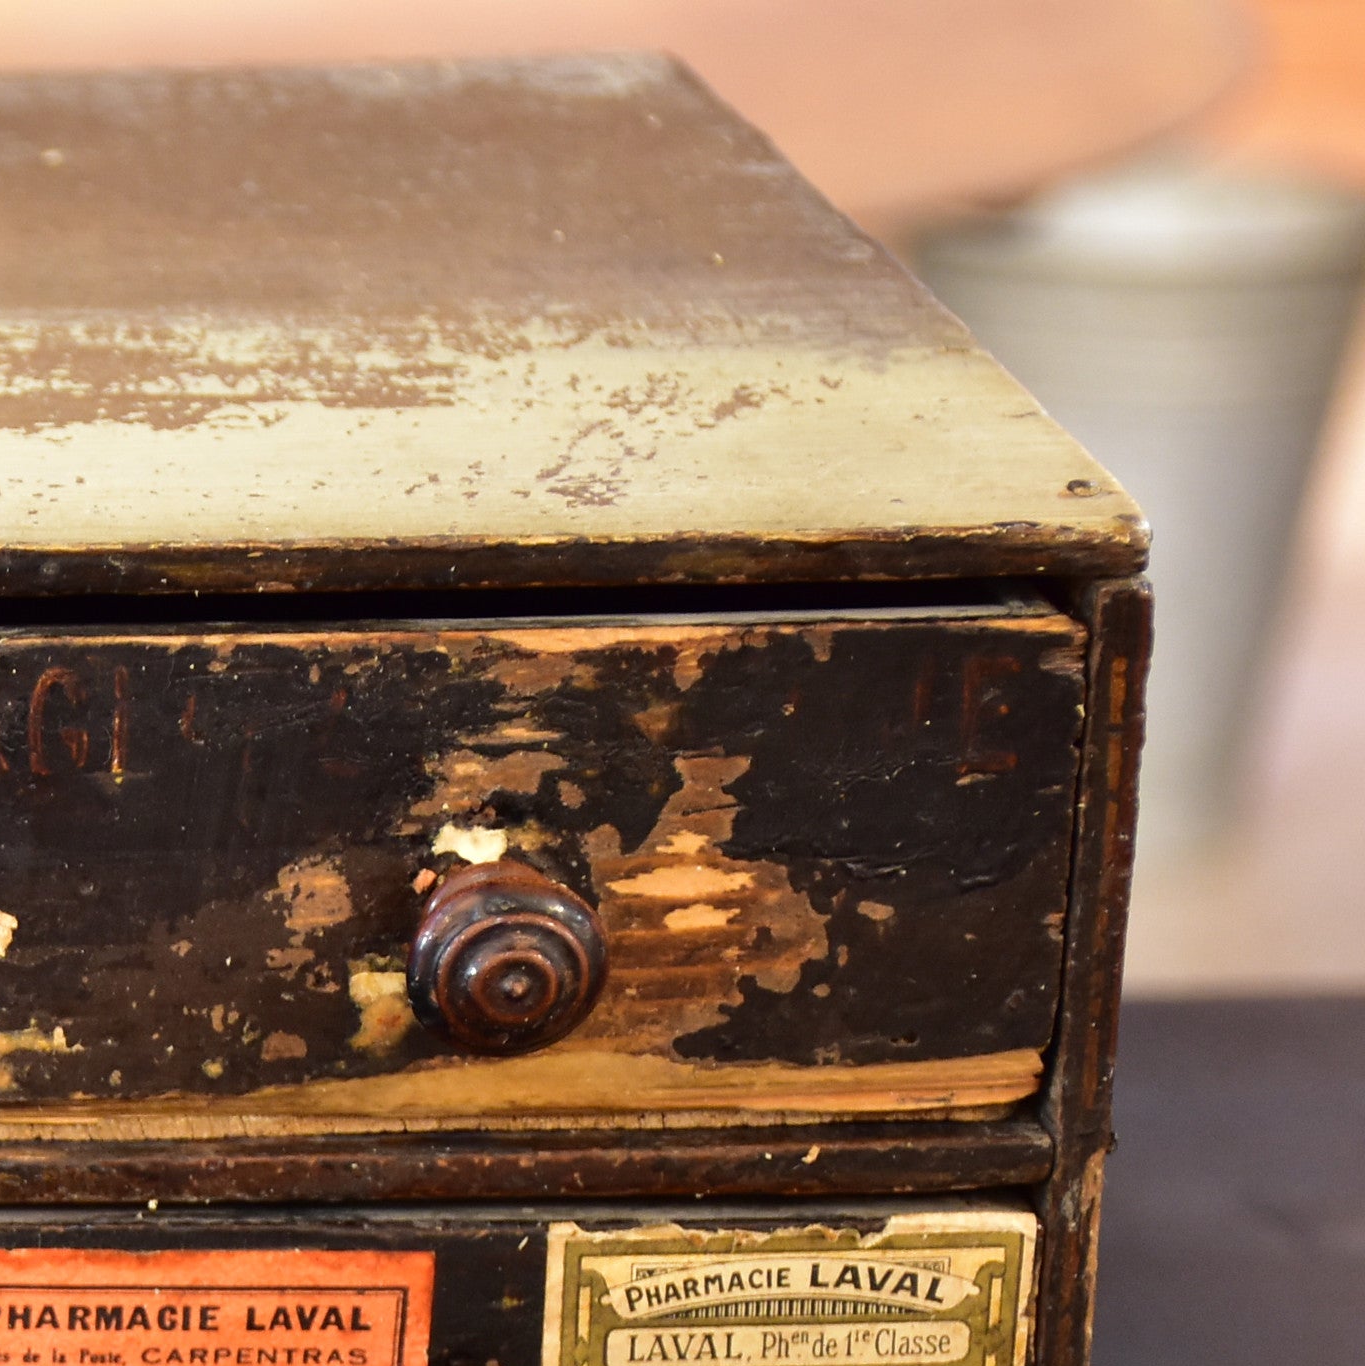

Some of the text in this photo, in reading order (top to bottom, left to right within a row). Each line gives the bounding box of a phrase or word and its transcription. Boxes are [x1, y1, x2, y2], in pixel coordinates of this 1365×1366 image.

[624, 1262, 947, 1313] PHARMACIE LAVAL
[245, 1305, 373, 1332] LAVAL
[22, 1347, 41, 1364] de
[52, 1347, 67, 1364] la
[140, 1347, 368, 1366] CARPENTRAS
[812, 1333, 838, 1359] de
[874, 1329, 952, 1357] Classe
